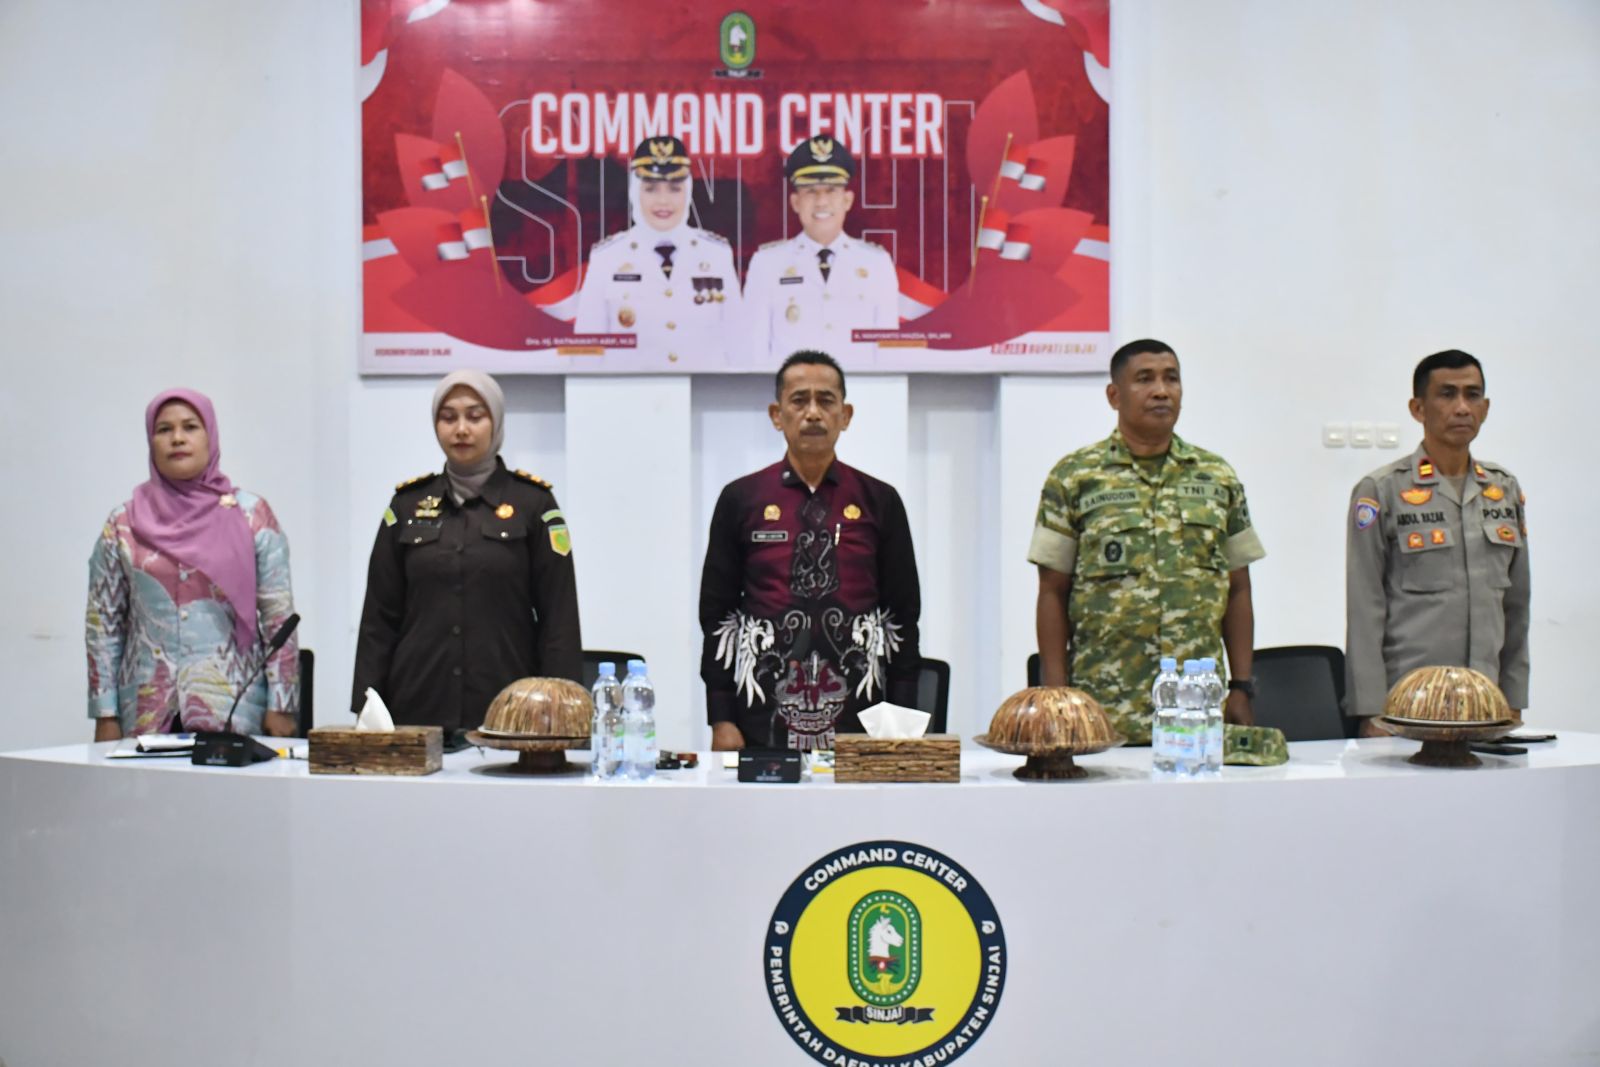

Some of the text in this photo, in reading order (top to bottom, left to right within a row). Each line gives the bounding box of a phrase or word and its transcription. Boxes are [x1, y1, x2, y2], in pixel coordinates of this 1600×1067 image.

[531, 93, 943, 155] COMMAND CENTER
[1085, 491, 1136, 508] SAINUDDIN
[1184, 486, 1205, 495] TNI
[804, 848, 968, 893] COMMAND CENTER
[770, 945, 824, 1053] PEMERINTAH
[982, 945, 1001, 1005] SINJAI
[866, 1006, 902, 1021] SINJAI
